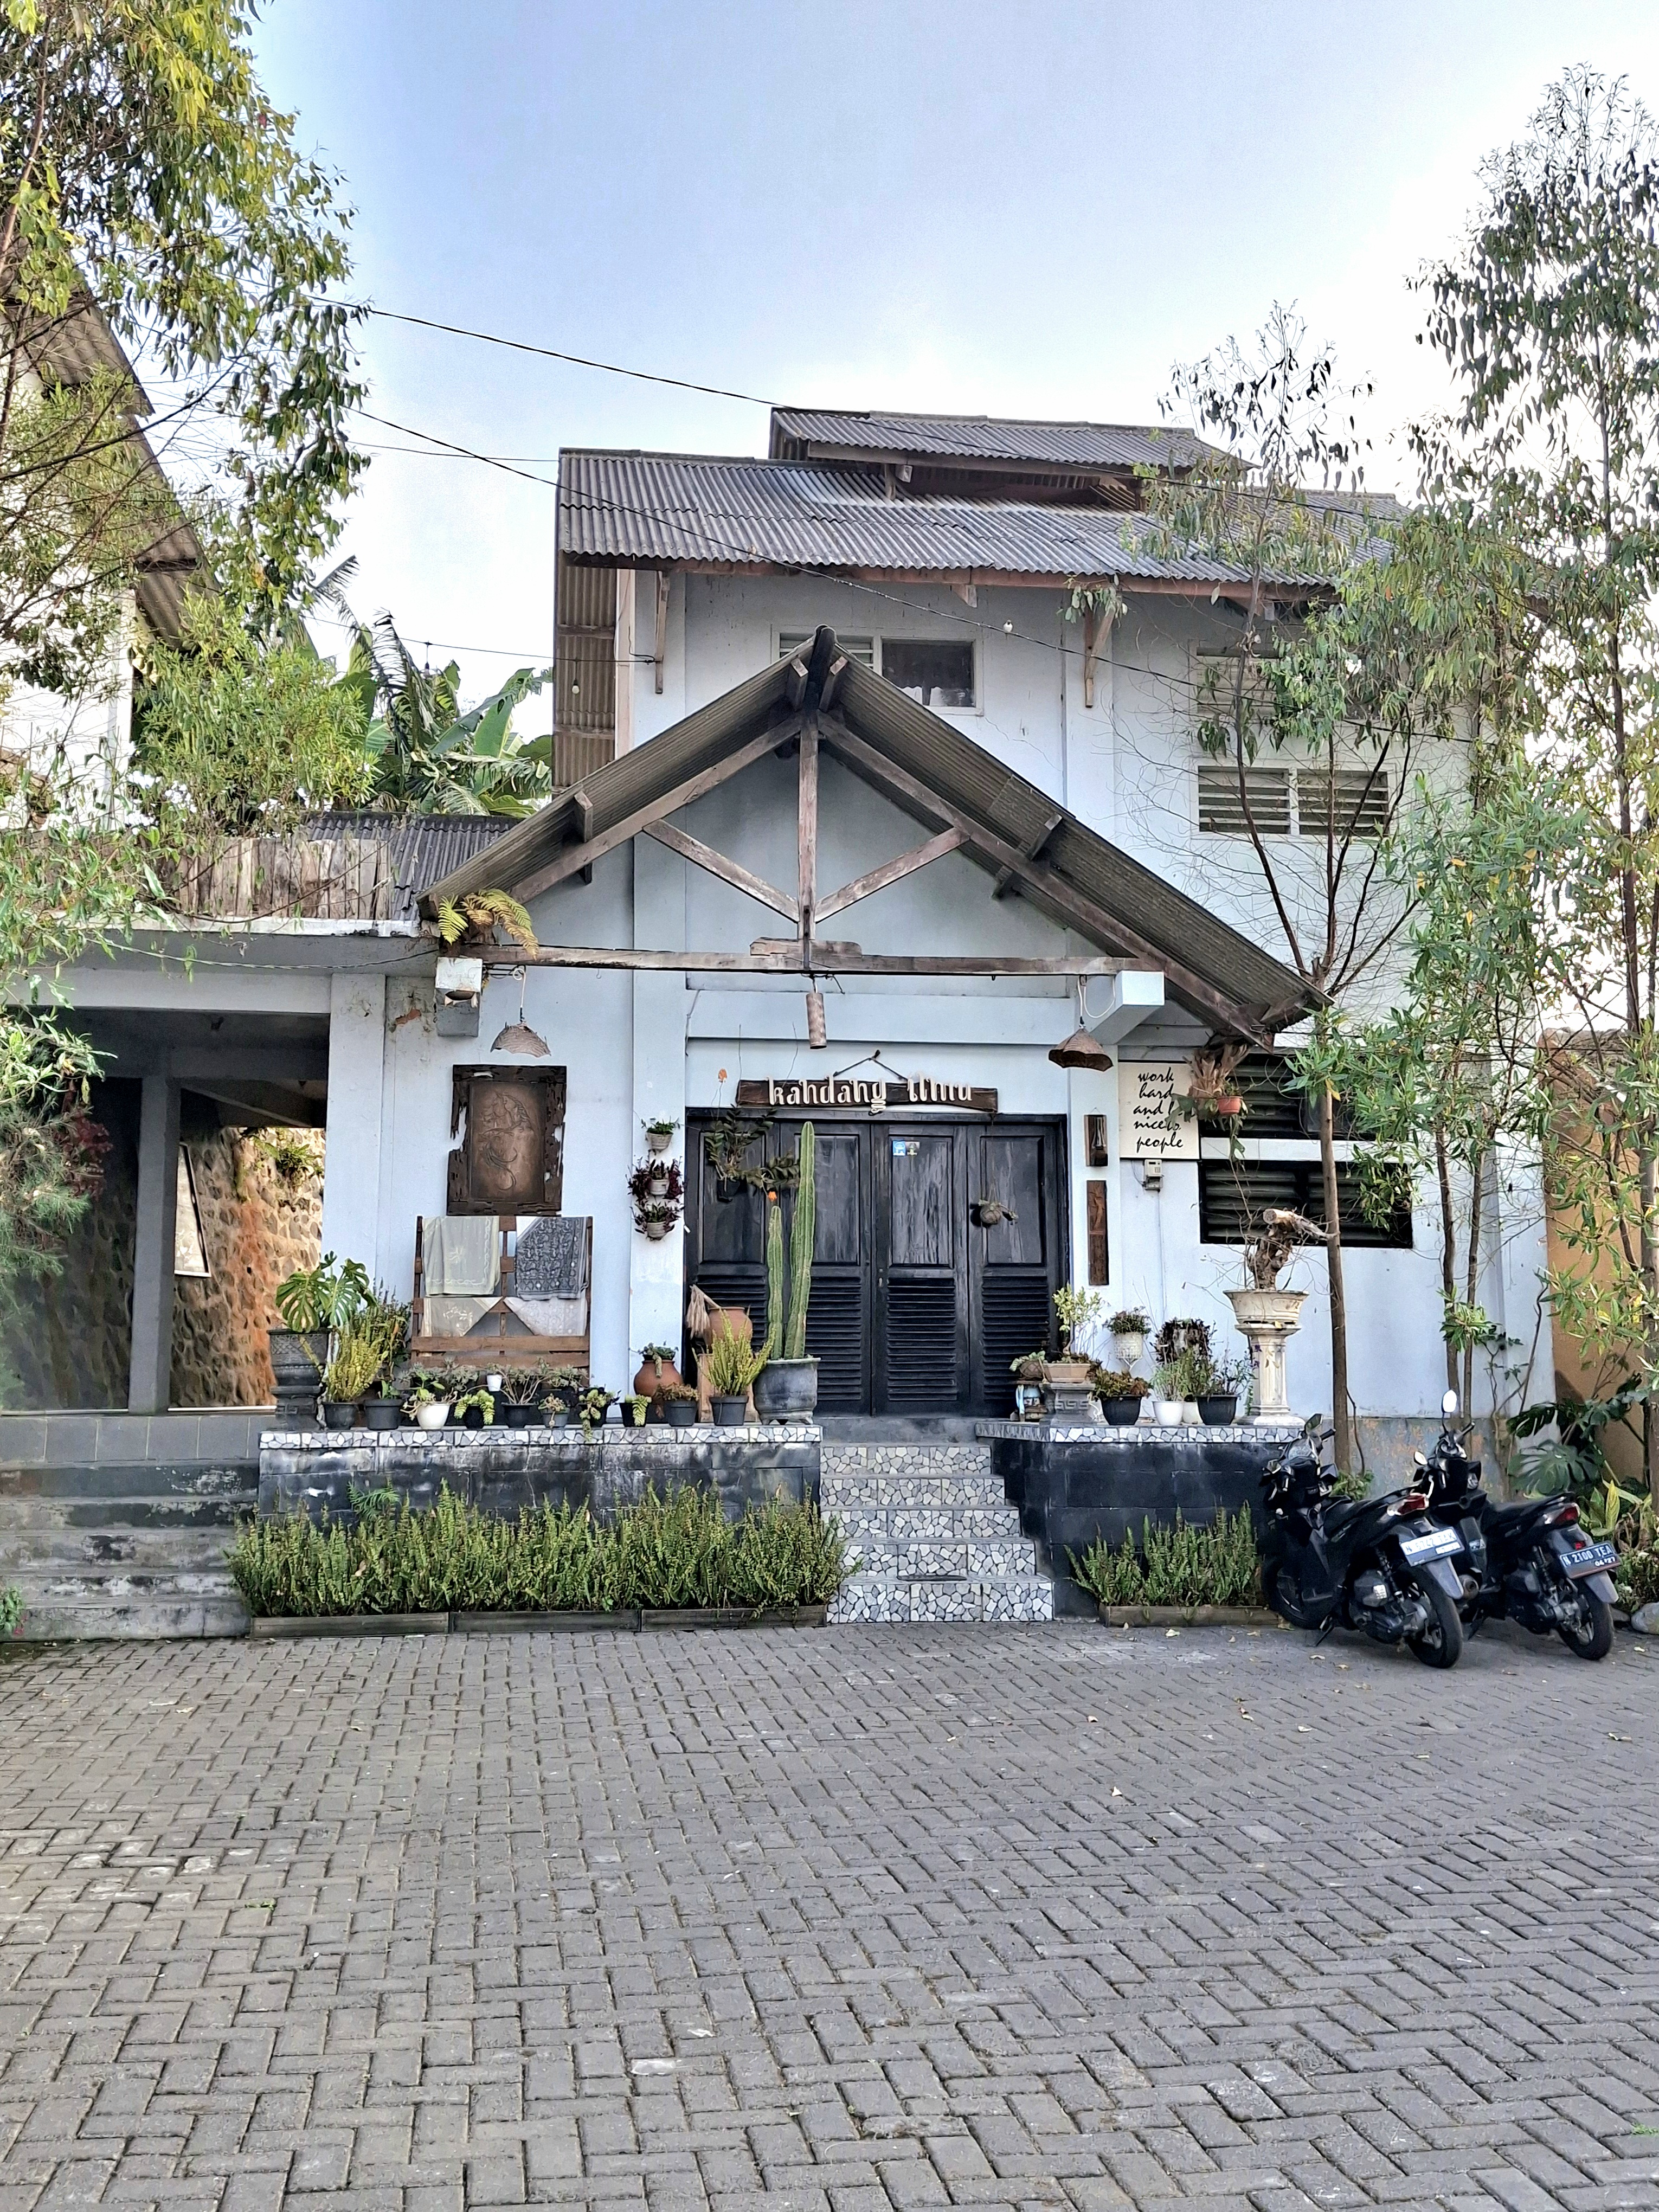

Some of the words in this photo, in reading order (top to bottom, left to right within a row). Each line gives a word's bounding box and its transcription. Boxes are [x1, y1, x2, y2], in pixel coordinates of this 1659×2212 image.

[1137, 1066, 1174, 1083] work
[766, 1074, 887, 1114] kandang
[907, 1071, 973, 1102] ilmu
[1139, 1082, 1174, 1099] hard
[1133, 1099, 1163, 1116] and
[1134, 1116, 1167, 1129] nice
[1136, 1131, 1184, 1154] people
[1562, 1555, 1572, 1566] N
[1572, 1550, 1594, 1563] 2100
[1594, 1545, 1613, 1557] TEA
